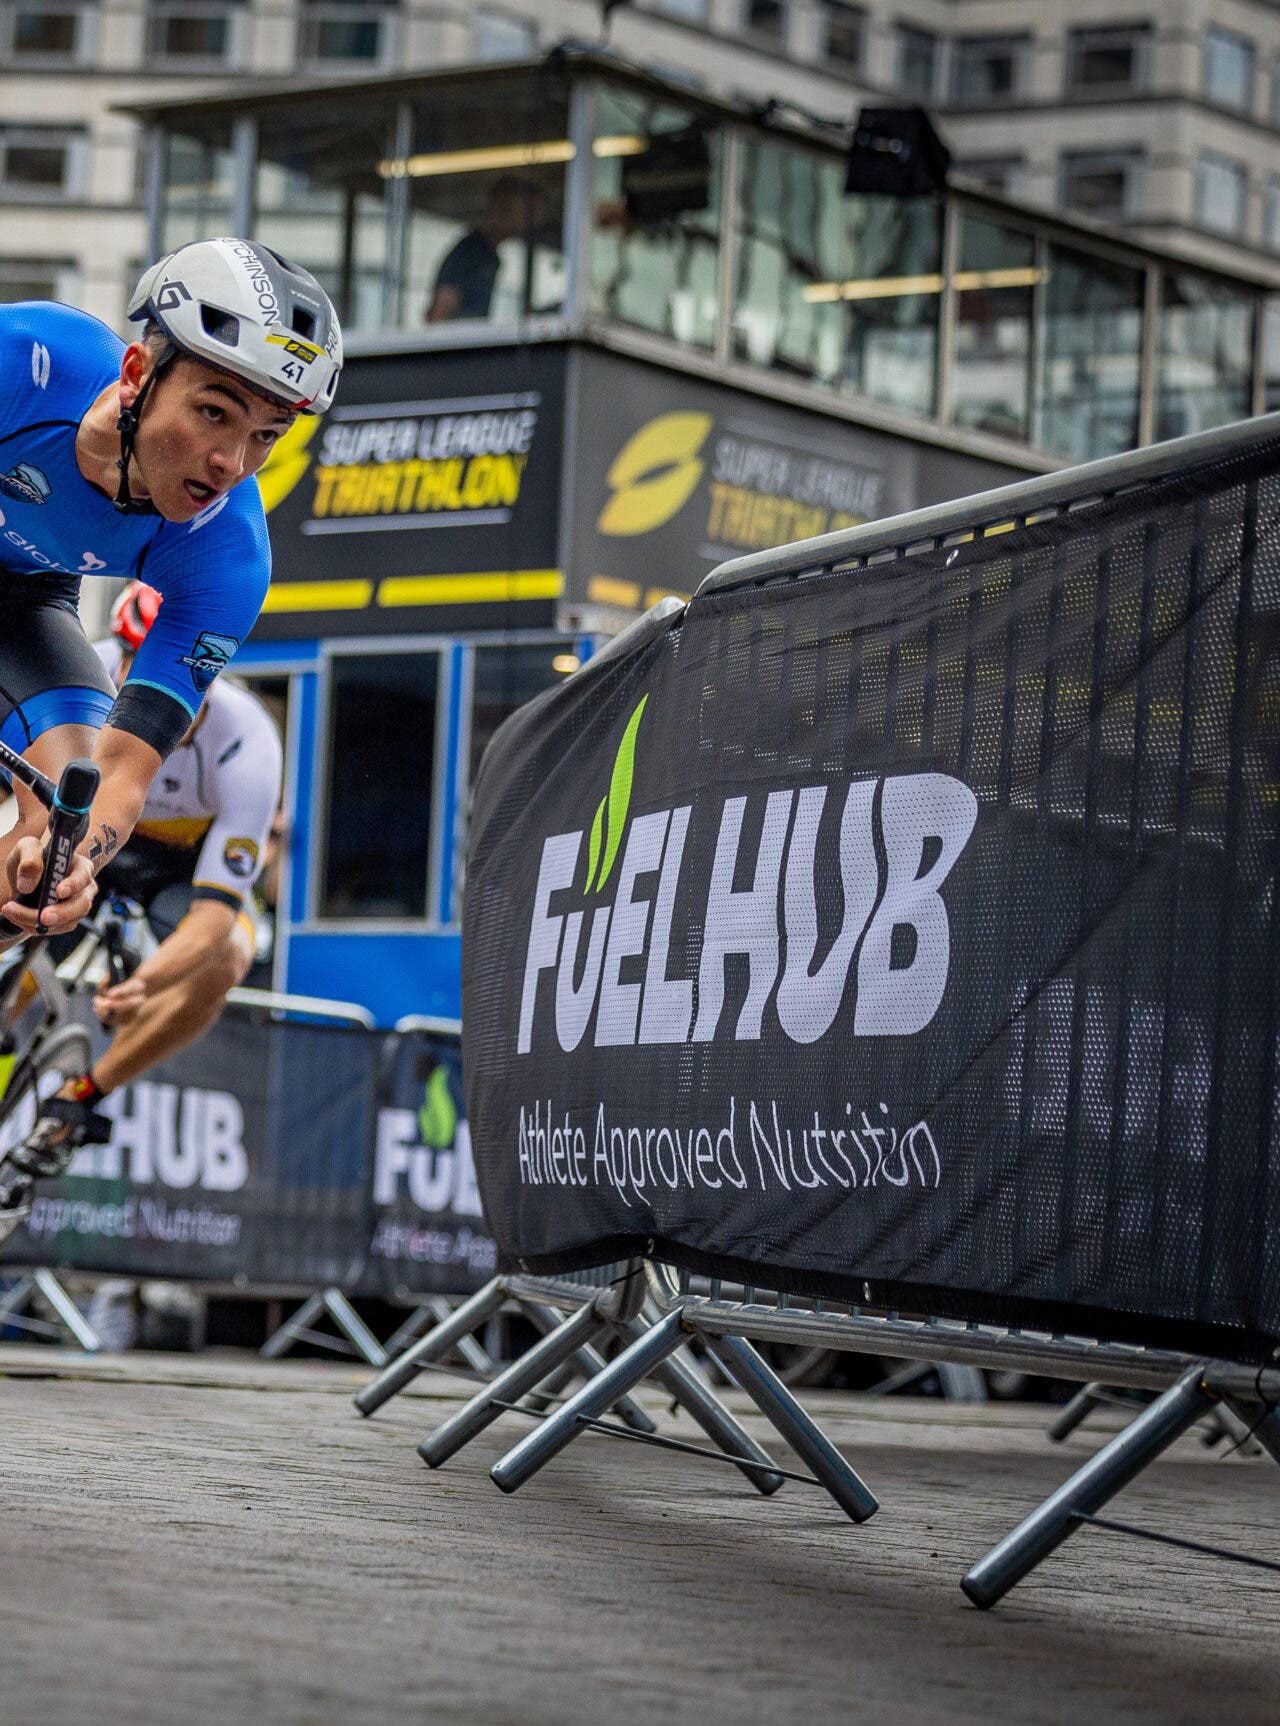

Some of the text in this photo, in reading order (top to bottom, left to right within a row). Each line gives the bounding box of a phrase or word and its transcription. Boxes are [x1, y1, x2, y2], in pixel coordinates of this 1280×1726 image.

[223, 239, 280, 327] TCHINSON
[281, 361, 305, 384] 41
[319, 410, 538, 466] SUPER LEAGUE
[312, 452, 528, 518] TRIATHLON
[708, 481, 866, 546] TRIATHL
[3, 530, 76, 575] glob
[517, 773, 978, 1055] FUELHUB
[519, 1096, 941, 1207] Athlete Approved Nutrition
[25, 1197, 138, 1242] pproved
